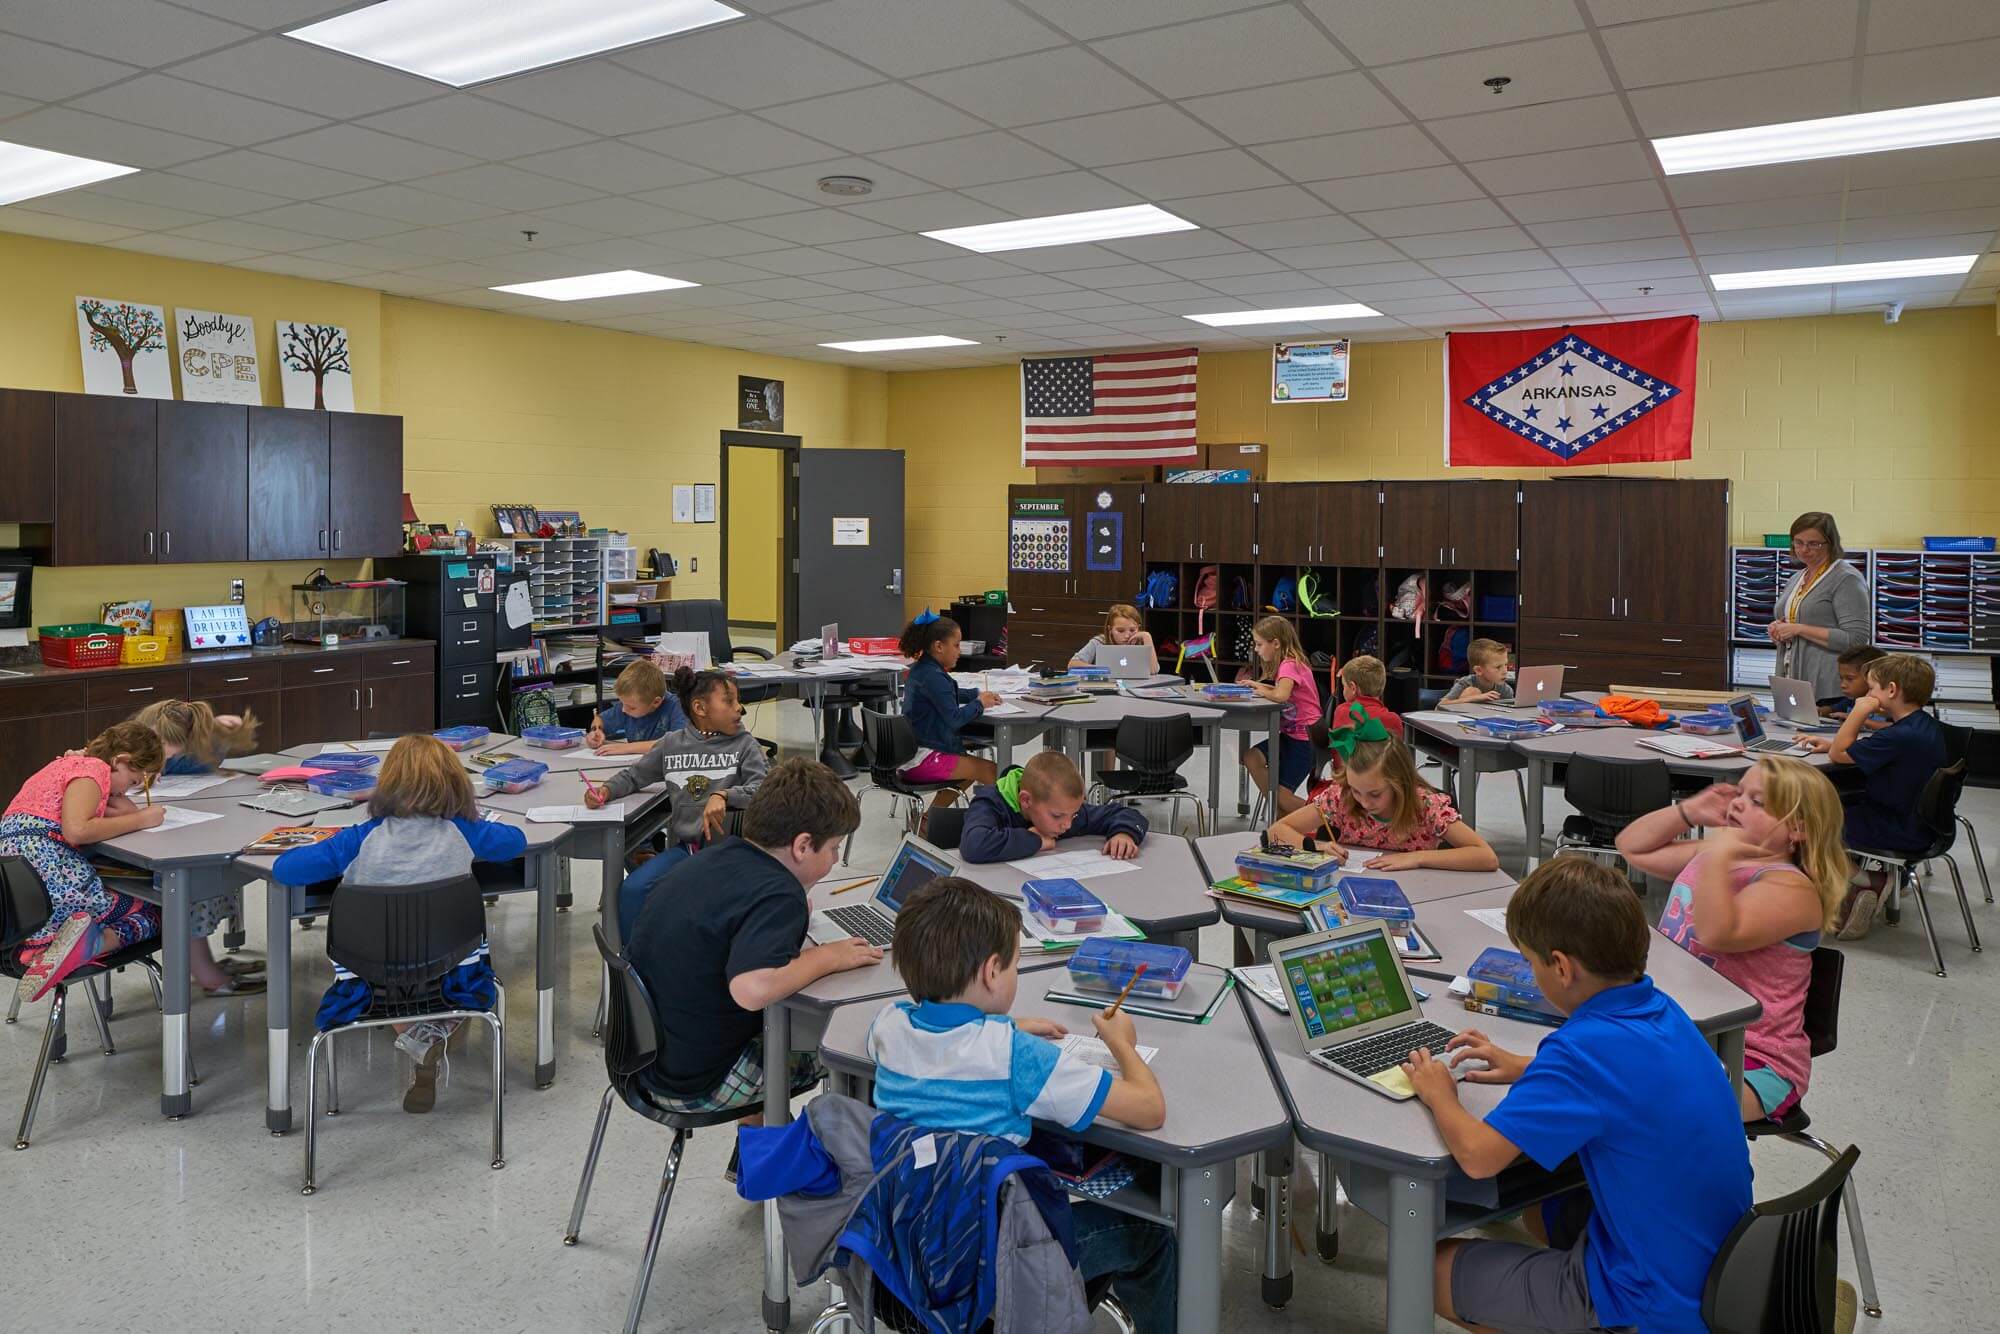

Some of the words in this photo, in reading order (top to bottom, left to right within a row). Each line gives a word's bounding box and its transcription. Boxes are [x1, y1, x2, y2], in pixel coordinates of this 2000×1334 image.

[183, 348, 256, 382] CPE
[1522, 385, 1617, 400] ARKANSAS
[1019, 503, 1059, 511] SEPTEMBER
[189, 609, 194, 619] I
[201, 609, 215, 618] AM
[223, 607, 242, 617] THE
[194, 621, 243, 633] DRIVER!
